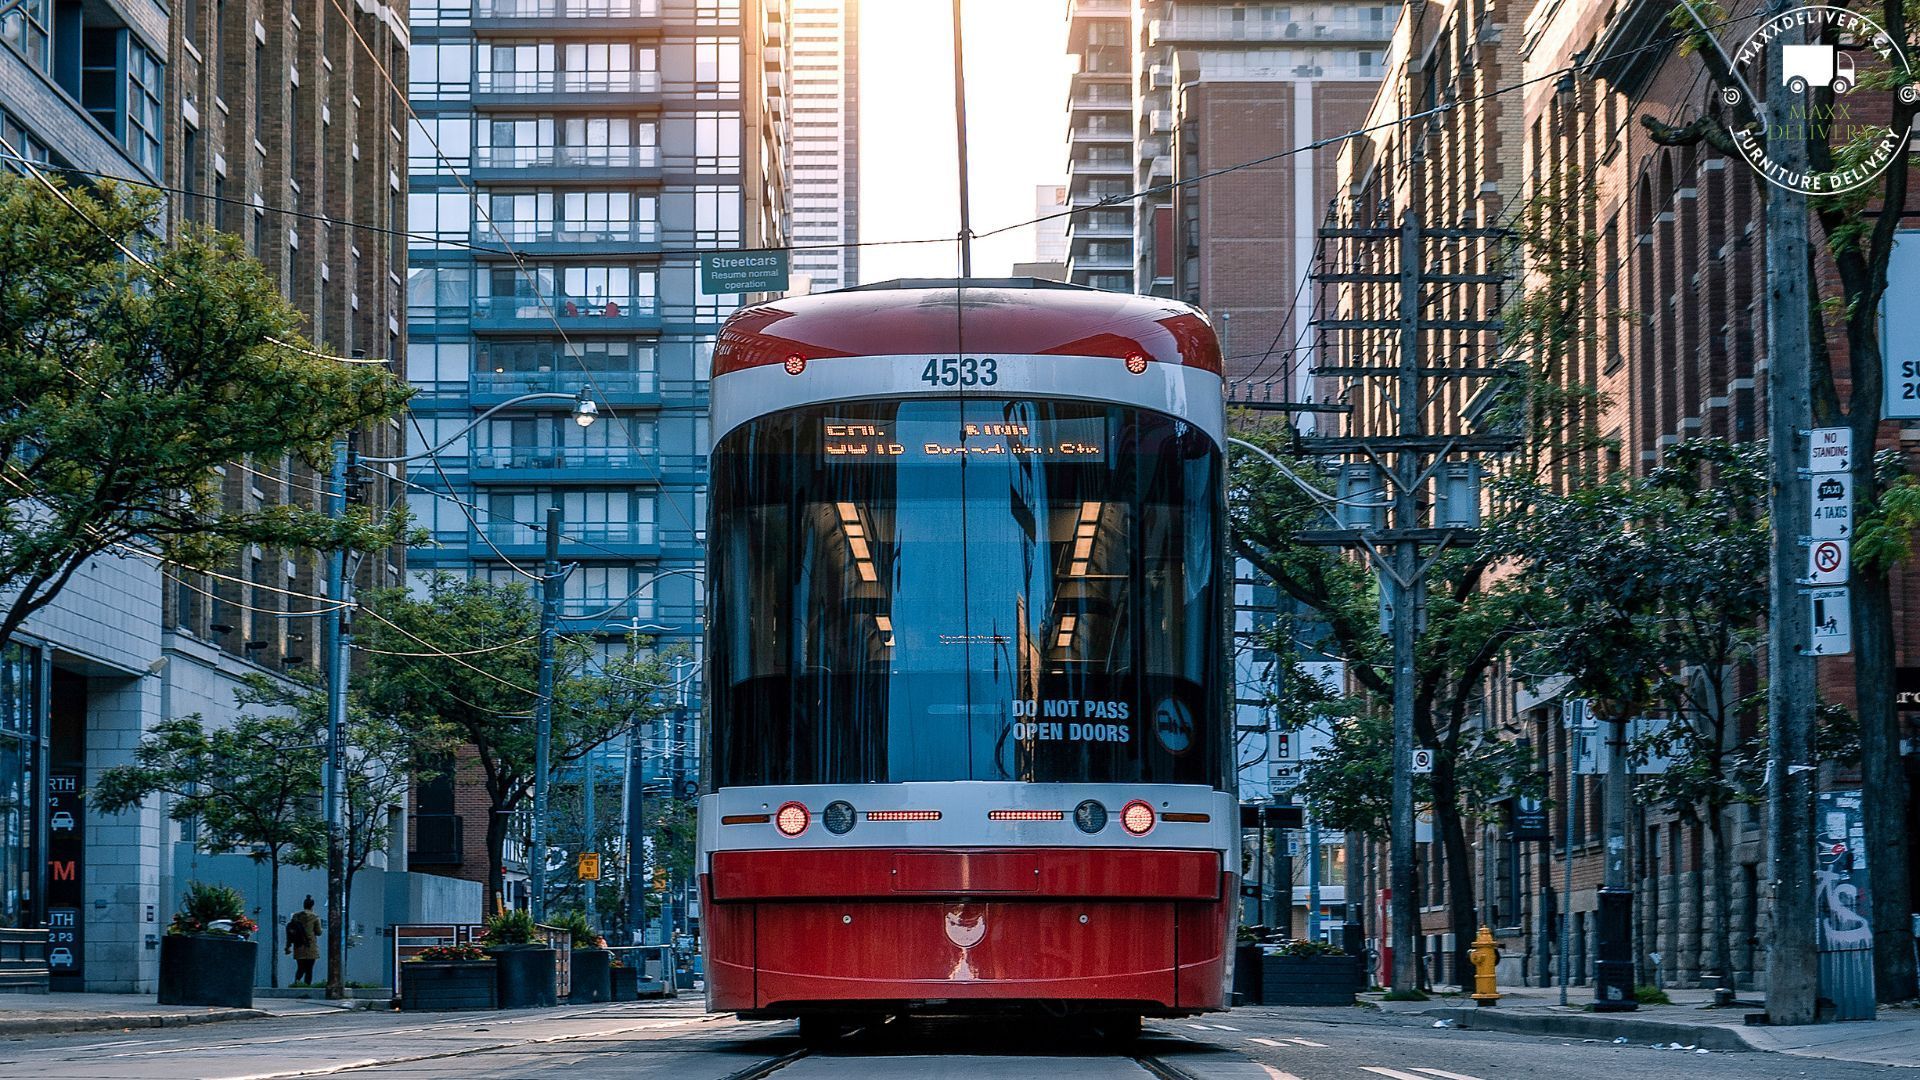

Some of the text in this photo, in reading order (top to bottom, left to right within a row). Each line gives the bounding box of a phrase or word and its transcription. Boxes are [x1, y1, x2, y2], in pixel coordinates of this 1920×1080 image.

[712, 256, 777, 268] Streetcars
[711, 269, 779, 280] Resume normal
[724, 280, 766, 291] operation
[921, 358, 998, 386] 4533
[1824, 432, 1837, 444] NO
[1812, 445, 1849, 458] STANDING
[1821, 485, 1840, 495] TAXI
[1814, 505, 1847, 519] 4 TAXIS
[1012, 699, 1130, 720] DO NOT PASS
[1013, 722, 1130, 742] OPEN DOORS
[59, 932, 73, 942] P3
